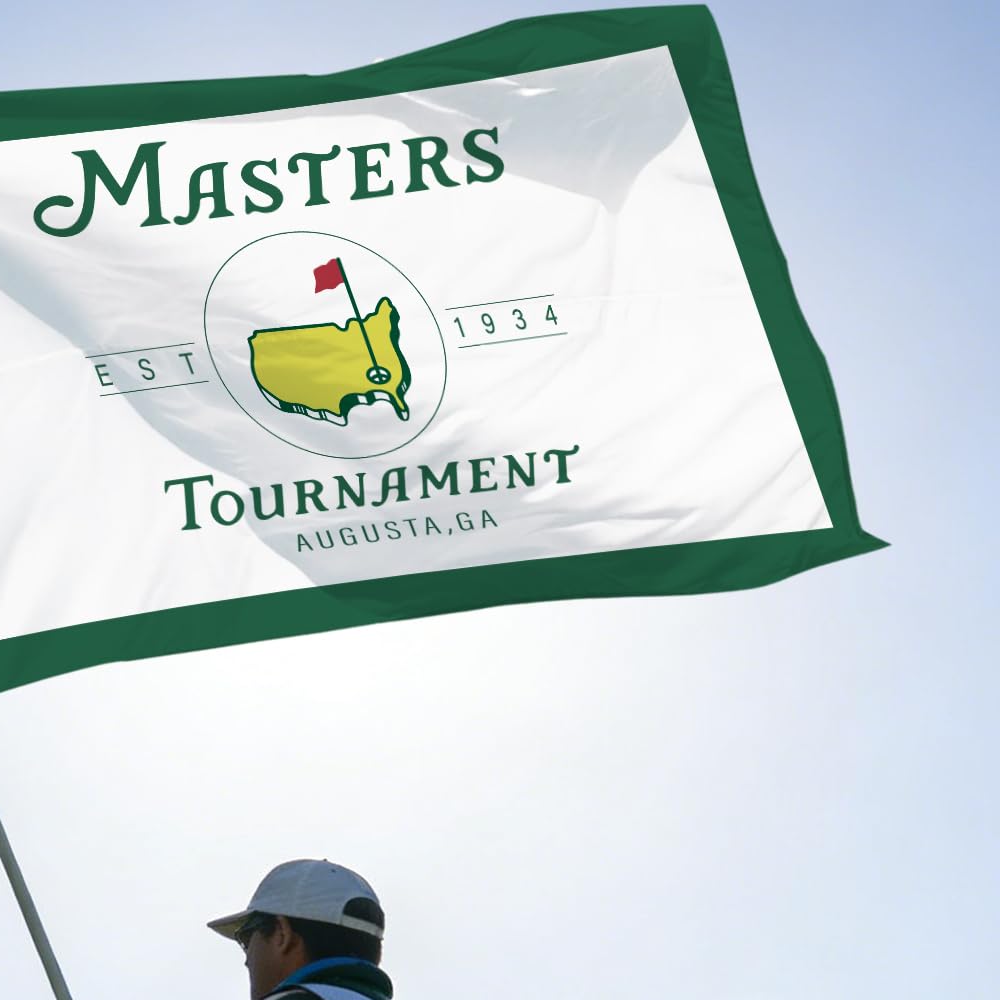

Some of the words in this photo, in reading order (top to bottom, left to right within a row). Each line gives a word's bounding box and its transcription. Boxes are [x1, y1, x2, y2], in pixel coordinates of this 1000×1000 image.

[33, 126, 505, 238] MASTERS
[93, 352, 196, 387] EST
[453, 304, 558, 338] 1934
[164, 444, 580, 531] TOURNAMENT
